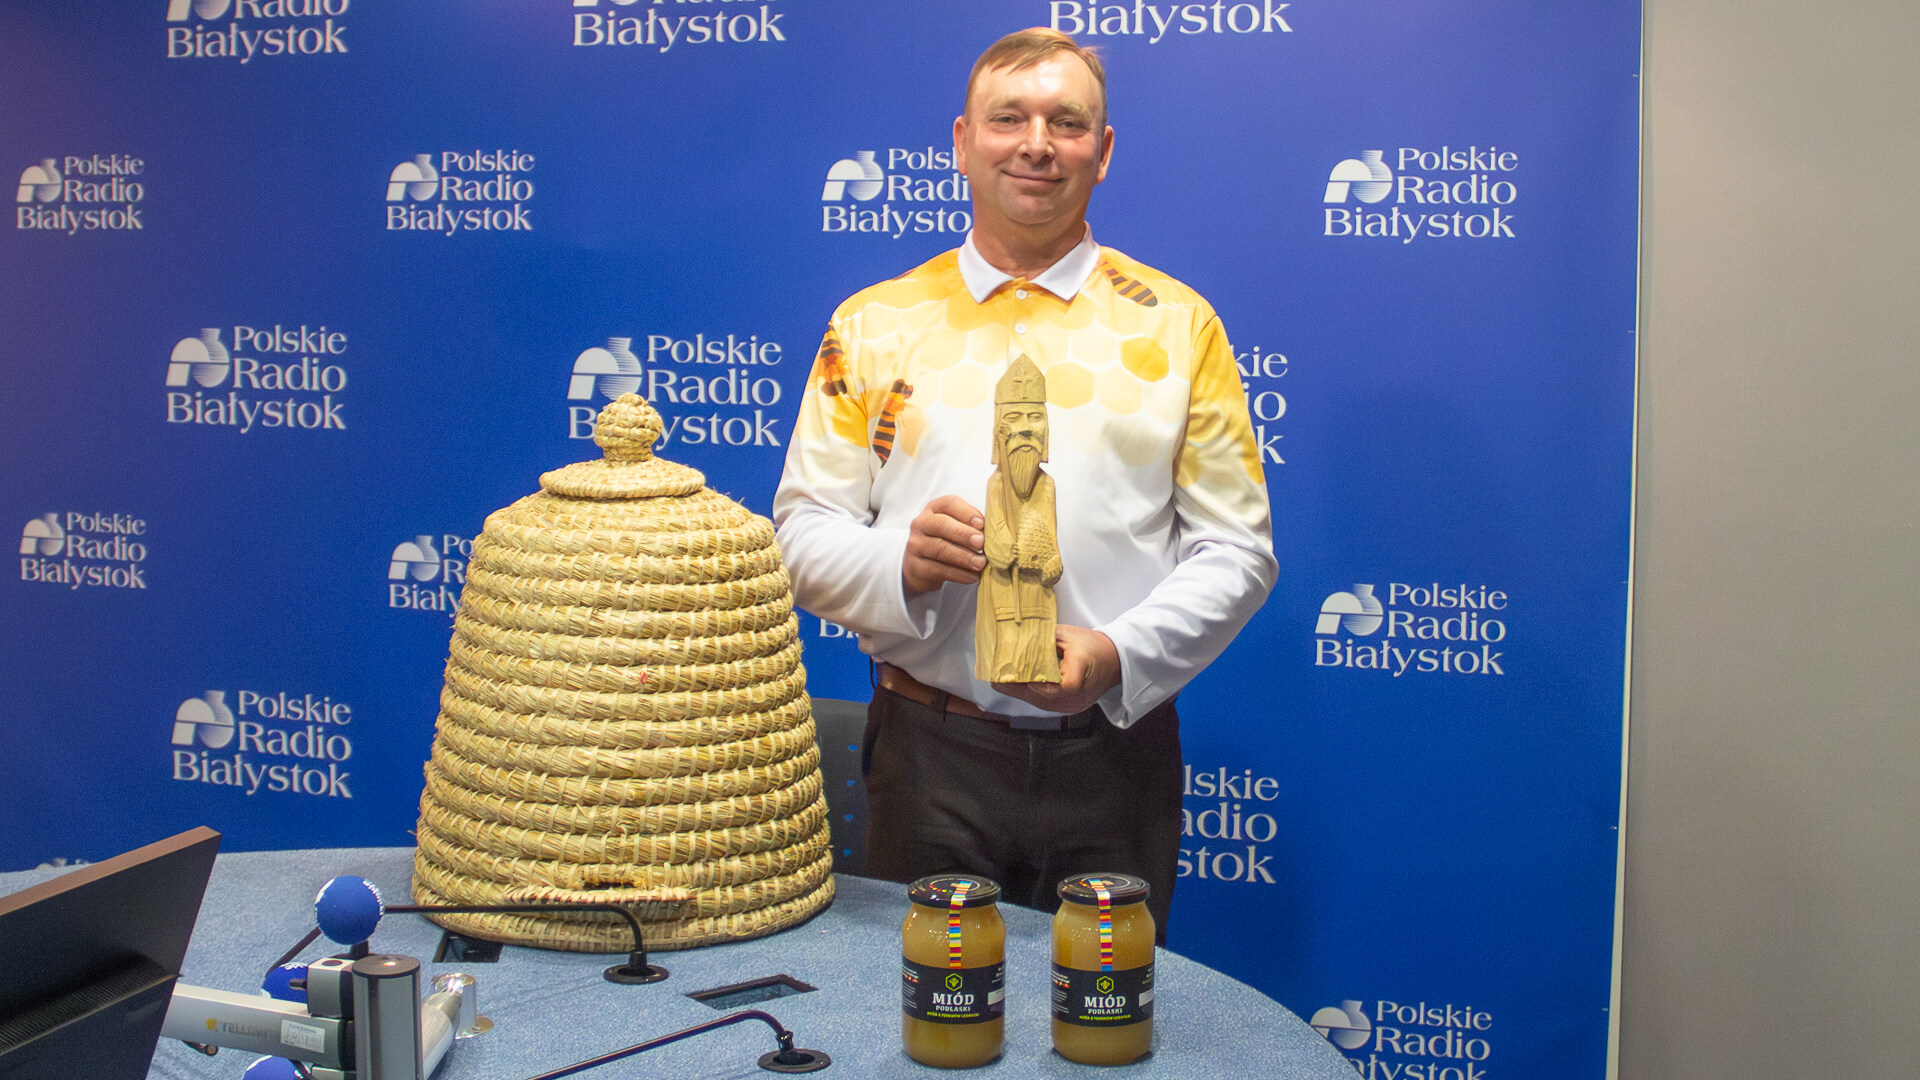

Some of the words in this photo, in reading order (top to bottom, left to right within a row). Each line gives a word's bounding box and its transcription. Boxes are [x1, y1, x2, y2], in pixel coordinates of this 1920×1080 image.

[573, 4, 786, 53] Białystok
[1049, 0, 1293, 44] Białystok
[167, 19, 348, 64] Białystok
[64, 155, 145, 176] Polskie
[441, 149, 535, 172] Polskie
[888, 146, 958, 170] Pols
[1398, 145, 1518, 172] Polskie
[64, 178, 144, 202] Radio
[440, 174, 534, 201] Radio
[887, 172, 971, 201] Radi
[1396, 174, 1517, 204] Radio
[16, 206, 143, 235] Białystok
[386, 204, 532, 236] Białystok
[822, 203, 972, 239] Białysto
[1323, 206, 1516, 244] Białystok
[233, 324, 347, 355] Polskie
[647, 333, 782, 366] Polskie
[233, 356, 346, 391] Radio
[648, 367, 782, 406] Radio
[166, 392, 346, 434] Białystok
[568, 406, 781, 451] Bystok
[66, 511, 146, 536] Polskie
[66, 534, 146, 562] Radio
[20, 558, 147, 590] Białystok
[389, 584, 462, 618] Biały
[1389, 582, 1508, 611] Polskie
[1387, 610, 1506, 642] Radio
[1315, 638, 1505, 677] Białystok
[238, 690, 352, 725] Polskie
[237, 722, 353, 761] Radio
[172, 750, 353, 799] Białystok
[1183, 764, 1279, 801] lskie
[932, 991, 975, 1006] MIÓD
[1084, 994, 1126, 1008] MIÓD
[1375, 1000, 1493, 1031] Polskie
[1373, 1026, 1491, 1061] Radio
